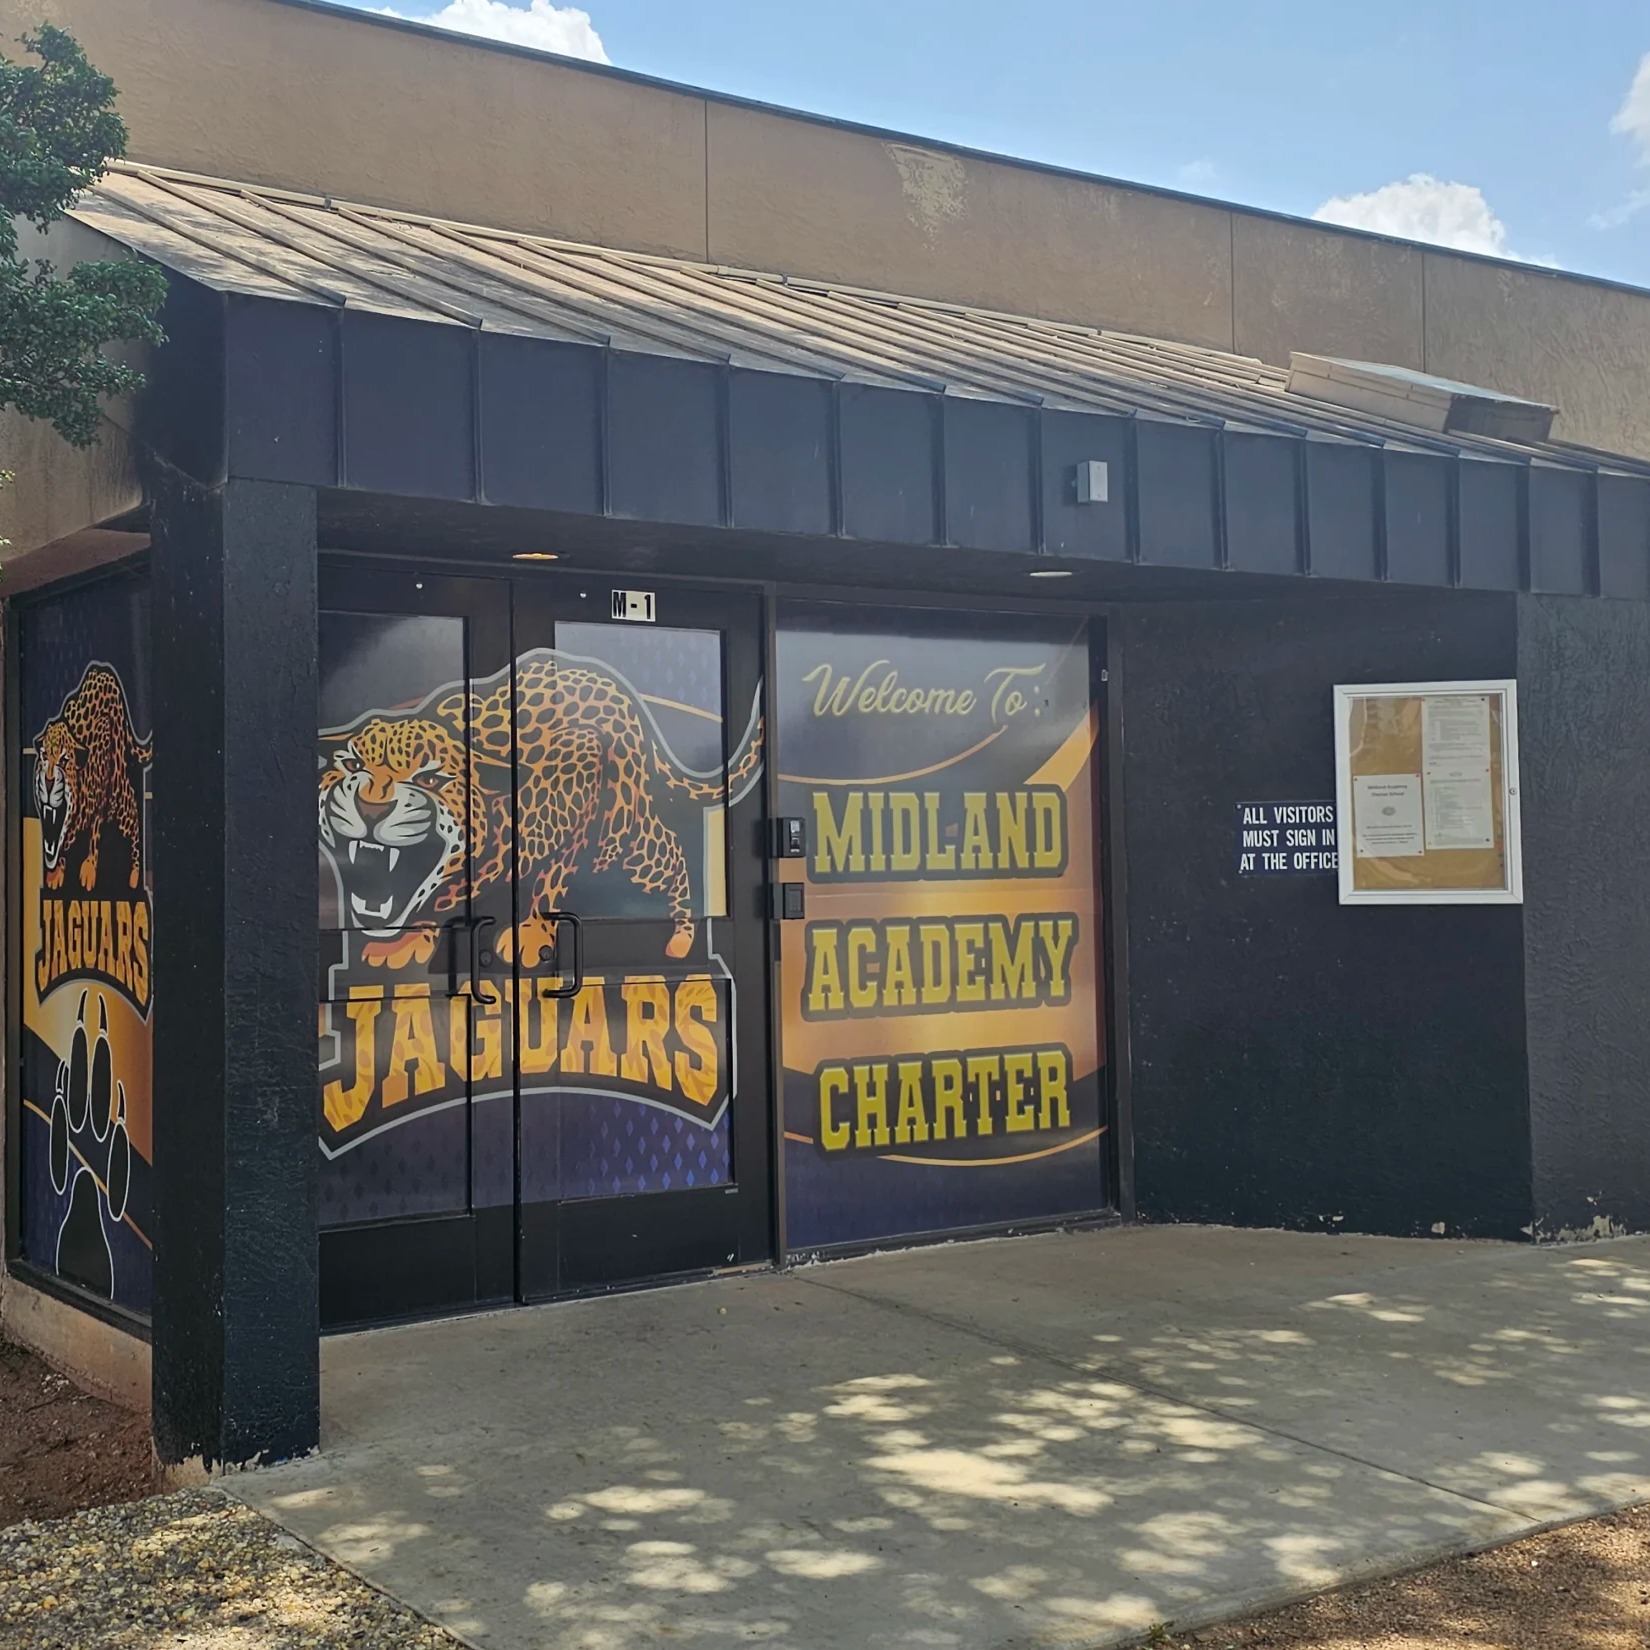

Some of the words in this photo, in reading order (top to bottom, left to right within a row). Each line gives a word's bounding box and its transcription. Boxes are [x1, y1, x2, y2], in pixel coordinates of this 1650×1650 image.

[802, 660, 976, 717] Welcome
[984, 663, 1046, 725] To:
[812, 792, 1064, 873] MIDLAND
[1243, 807, 1268, 825] ALL
[1273, 805, 1334, 824] VISITORS
[1243, 830, 1280, 848] MUST
[1286, 829, 1316, 847] SIGN
[1322, 829, 1335, 846] IN
[1240, 853, 1256, 871] AT
[1262, 853, 1288, 870] THE
[1293, 851, 1339, 870] OFFICE
[38, 899, 149, 1007] JAGUARS
[808, 919, 1073, 1012] ACADEMY
[323, 973, 719, 1132] JAGUARS
[820, 1050, 1071, 1151] CHARTER
